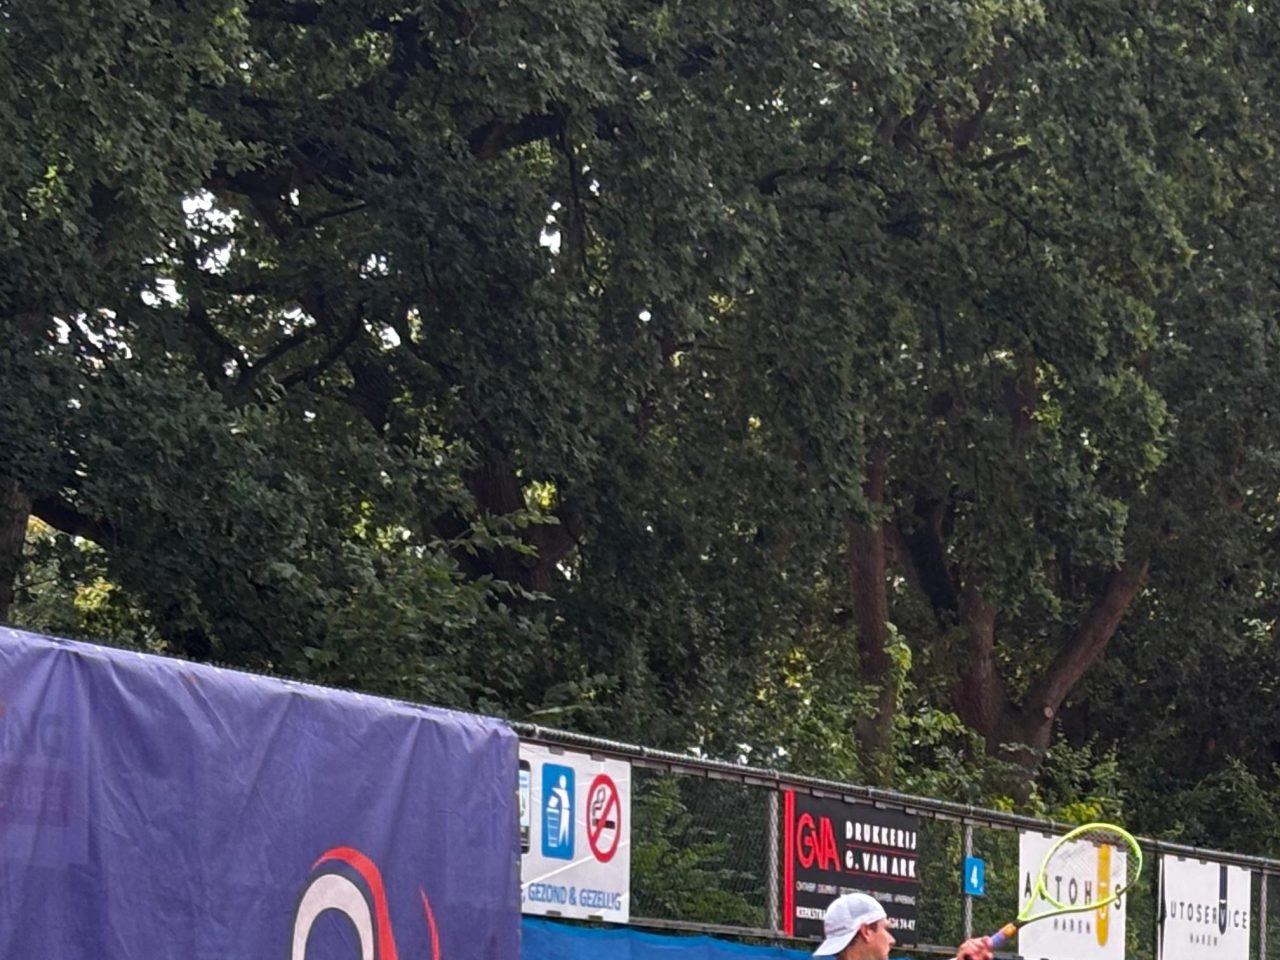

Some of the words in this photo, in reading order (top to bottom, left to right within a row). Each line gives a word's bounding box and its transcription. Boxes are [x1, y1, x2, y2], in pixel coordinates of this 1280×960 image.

[845, 820, 917, 850] DRUKKERIJ
[862, 852, 888, 874] VAN
[891, 856, 916, 878] ARK
[970, 865, 979, 888] 4
[528, 883, 567, 905] GEZOND
[568, 886, 577, 906] &
[580, 888, 622, 911] GEZELLIG
